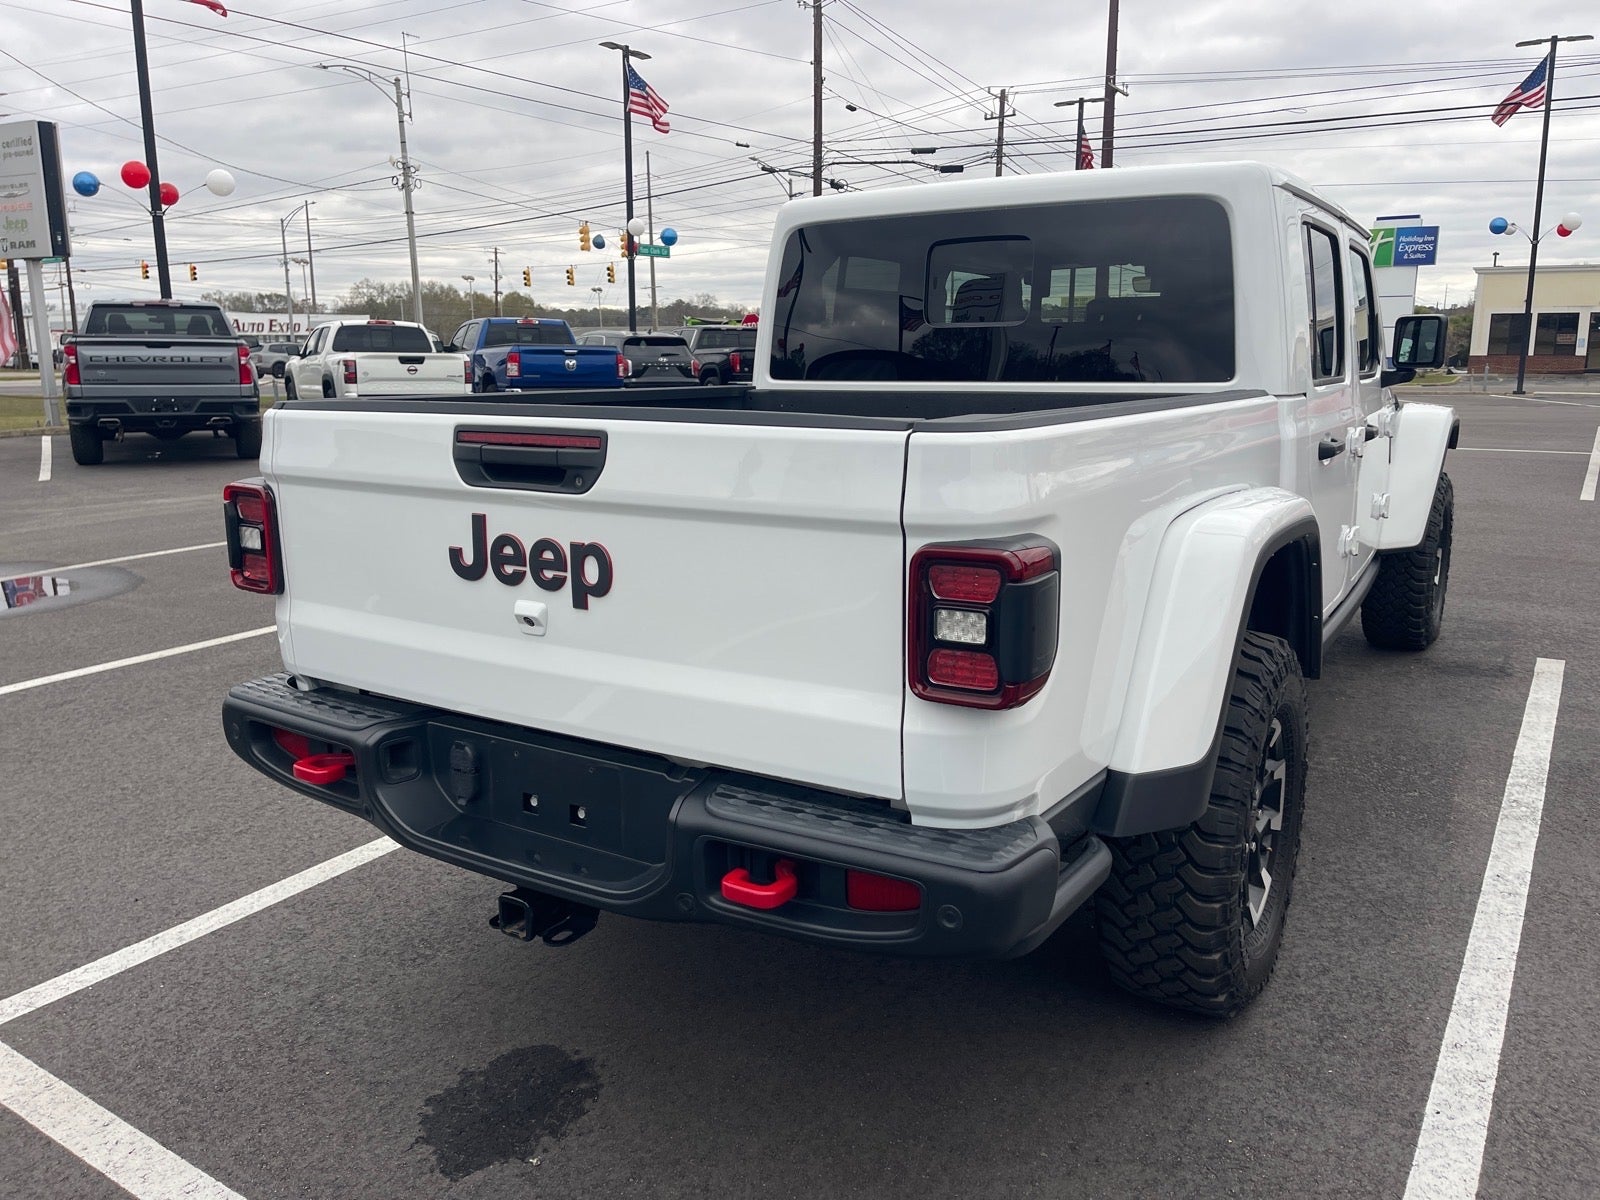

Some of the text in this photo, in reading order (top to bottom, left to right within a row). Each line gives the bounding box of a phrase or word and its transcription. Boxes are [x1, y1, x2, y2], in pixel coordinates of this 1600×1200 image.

[2, 136, 32, 149] certified
[3, 215, 28, 232] Jeep
[10, 240, 36, 249] RAM
[1398, 243, 1434, 253] Express
[89, 355, 228, 363] CHEVROLET
[448, 512, 614, 611] Jeep
